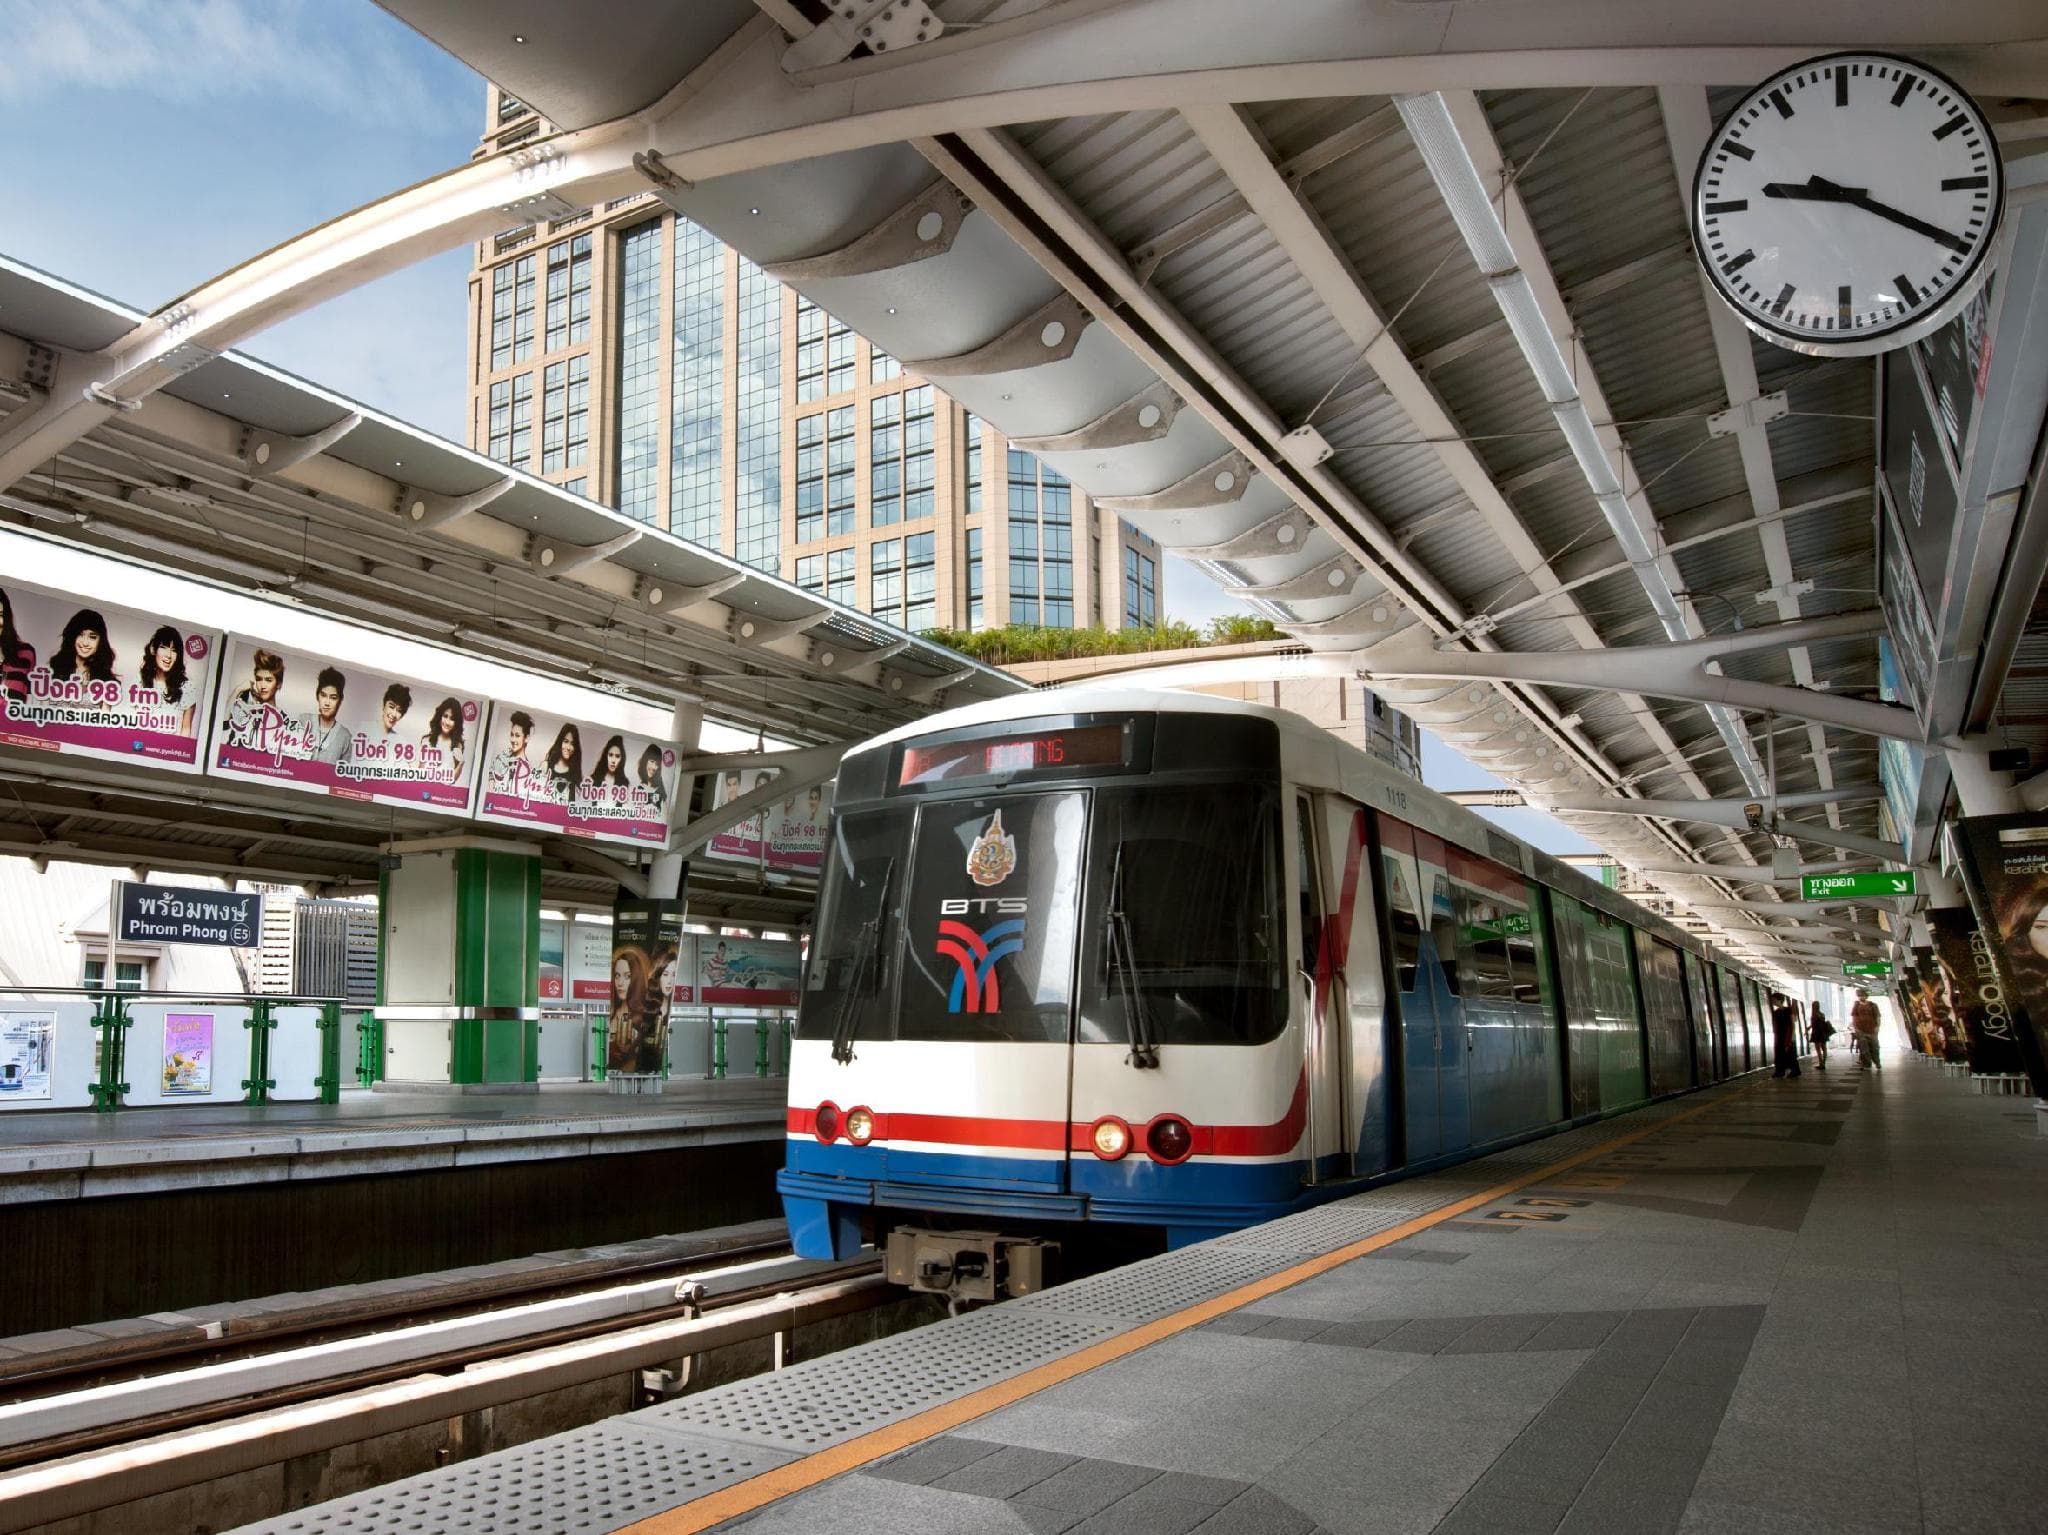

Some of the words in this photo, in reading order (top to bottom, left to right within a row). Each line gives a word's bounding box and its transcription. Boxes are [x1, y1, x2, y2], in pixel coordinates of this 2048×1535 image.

[90, 681, 119, 702] 98
[129, 684, 158, 705] fm
[394, 743, 414, 760] 98
[421, 744, 442, 762] fm
[612, 787, 627, 801] 98
[803, 825, 816, 837] 98
[1810, 877, 1856, 888] ทางออก
[1811, 887, 1831, 895] Exit
[139, 892, 250, 922] พร้อมพงษ์
[941, 897, 1029, 915] BTS
[129, 919, 178, 935] Phrom
[182, 923, 227, 942] Phong
[233, 928, 249, 940] E5
